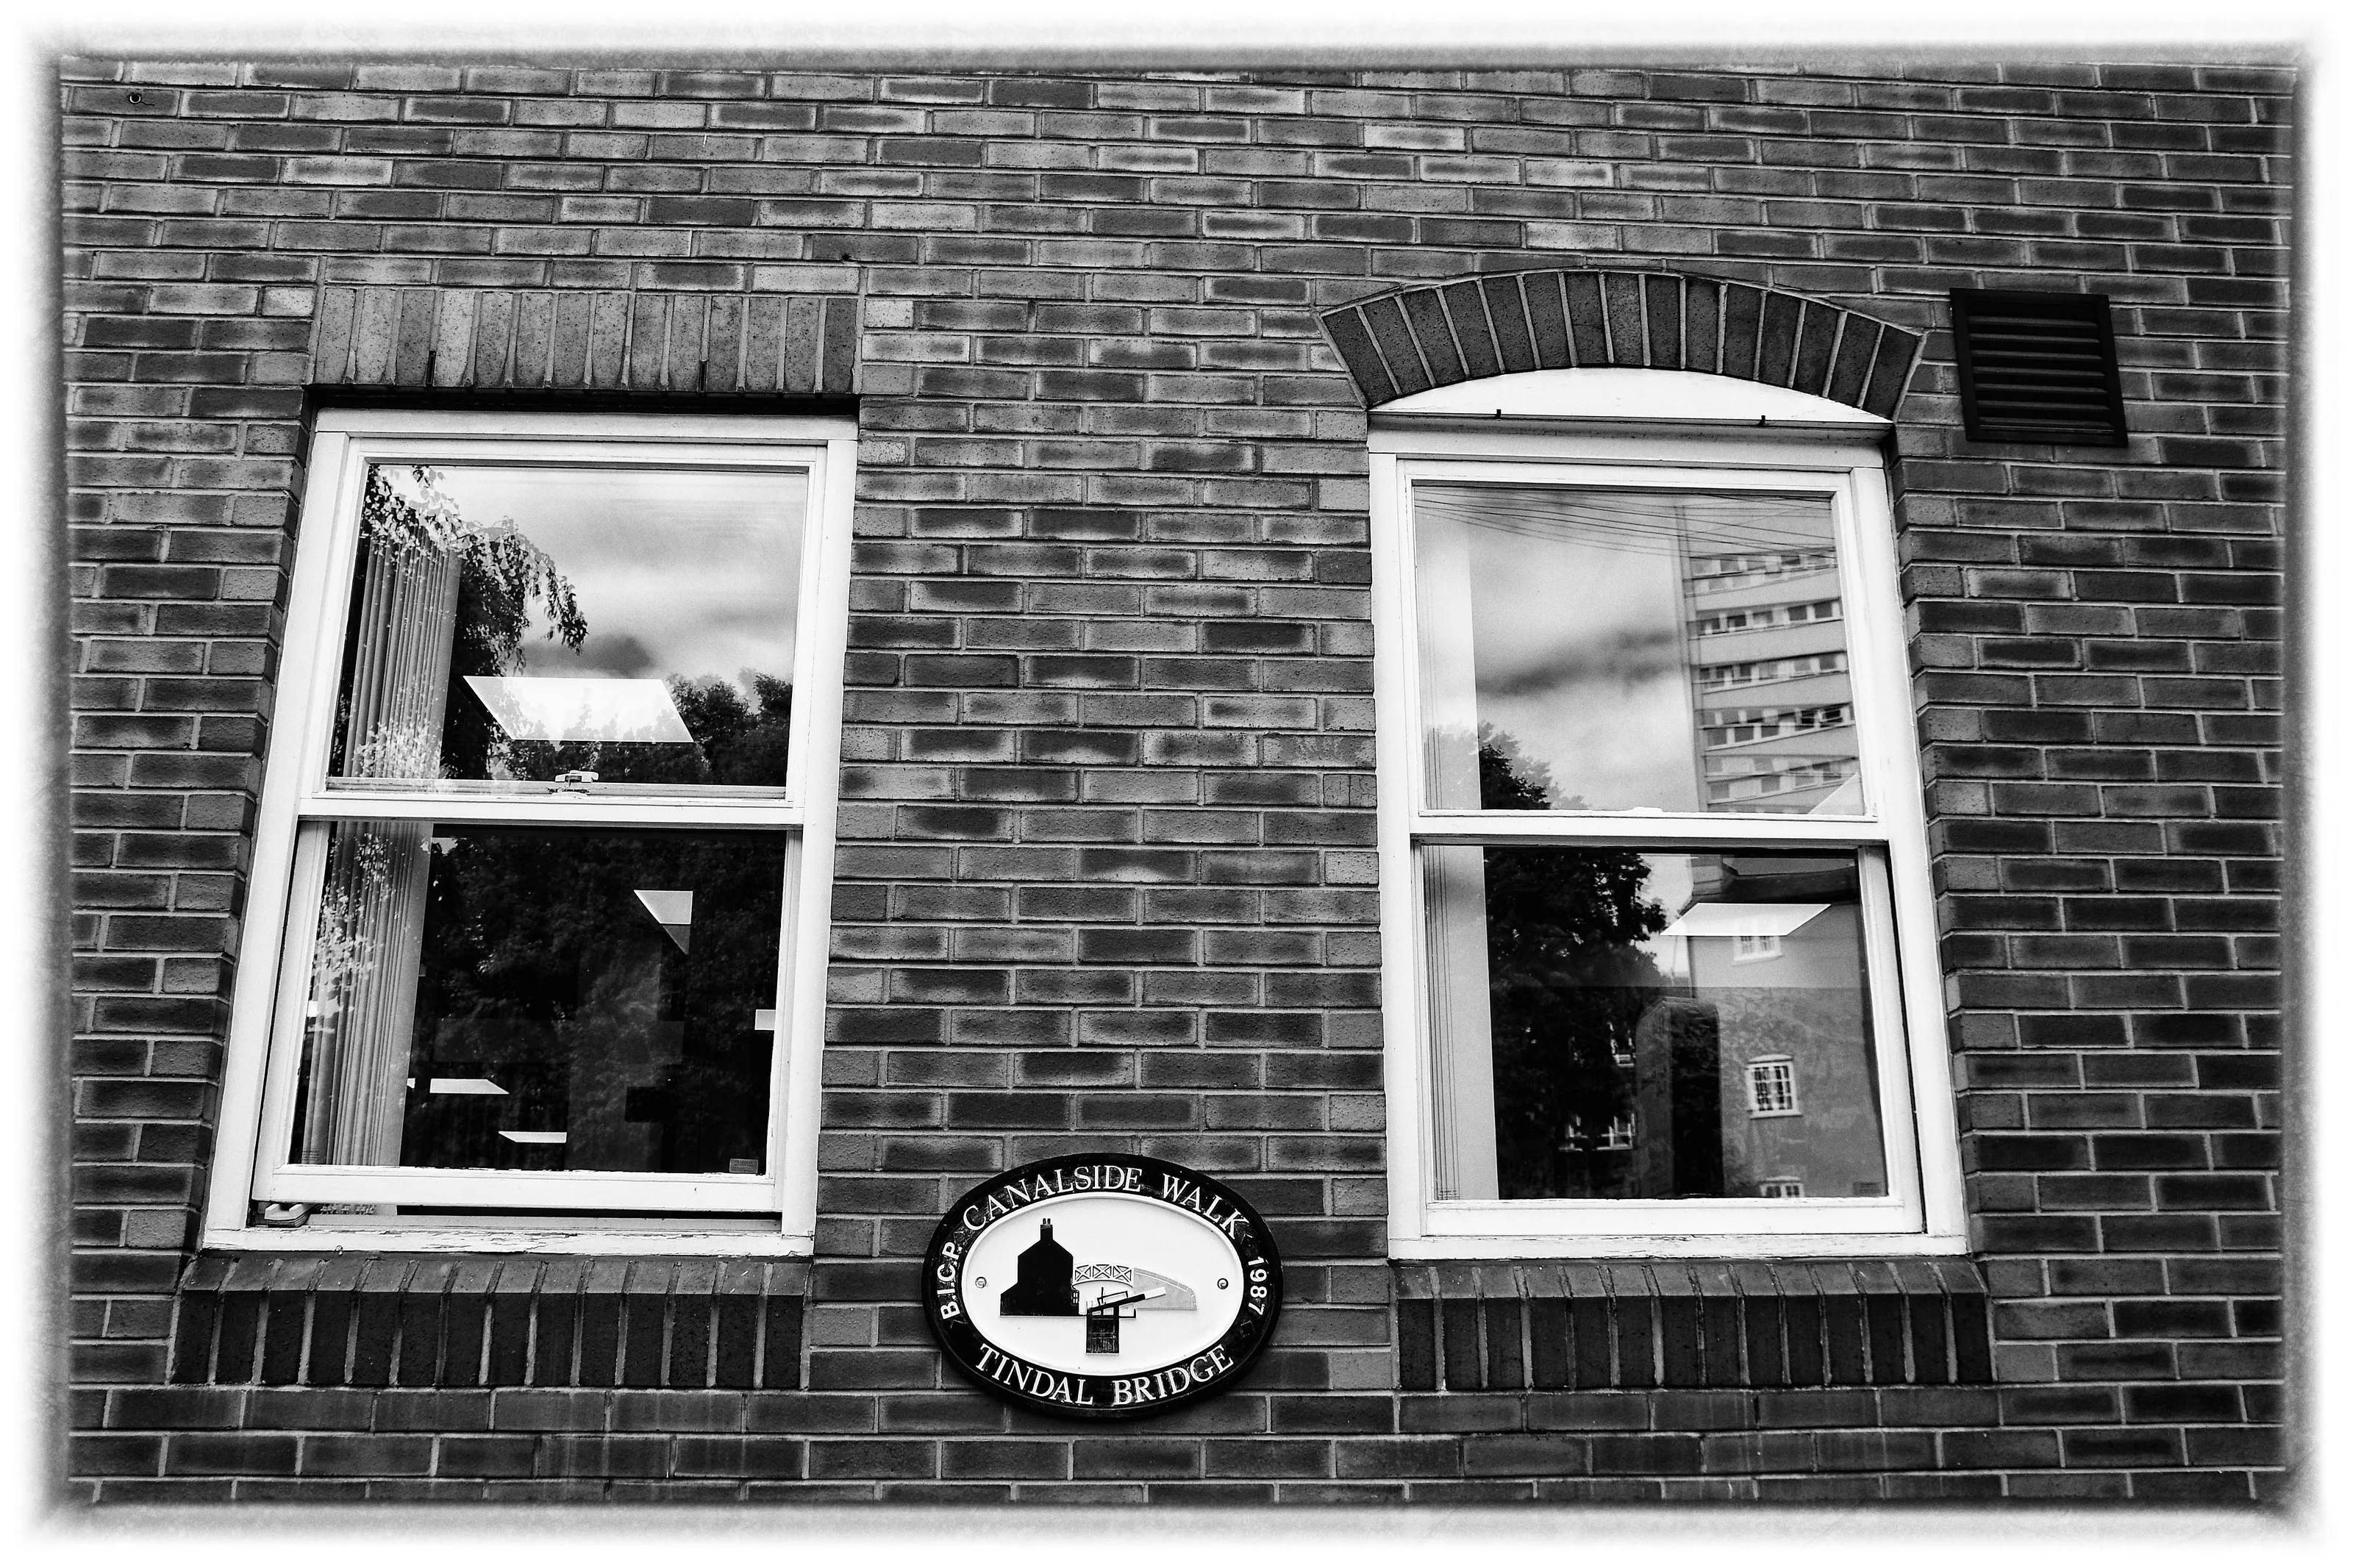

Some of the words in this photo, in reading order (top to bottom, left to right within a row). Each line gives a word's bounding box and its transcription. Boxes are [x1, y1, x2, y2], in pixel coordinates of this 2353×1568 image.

[963, 1165, 1143, 1231] CANALSIDE
[1162, 1173, 1250, 1240] WALK
[1248, 1256, 1268, 1315] 1987
[975, 1343, 1094, 1406] TINDAL
[1113, 1344, 1234, 1406] BRIDGE
